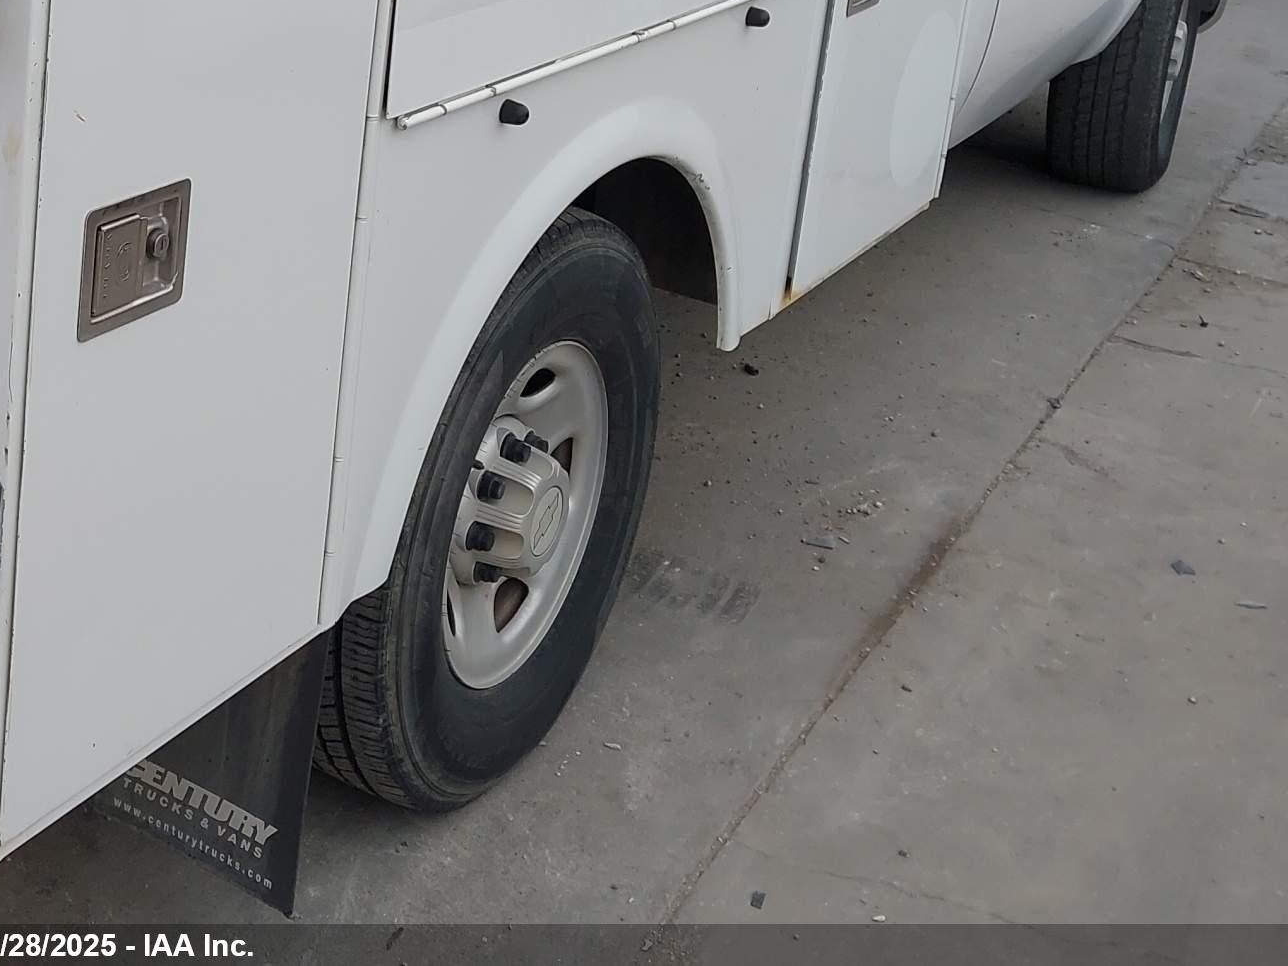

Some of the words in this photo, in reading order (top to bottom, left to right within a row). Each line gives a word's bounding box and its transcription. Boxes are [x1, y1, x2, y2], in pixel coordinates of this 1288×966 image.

[112, 796, 274, 891] www.centurytrucks.com
[121, 778, 194, 821] TRUCKS
[199, 817, 210, 830] &
[216, 825, 265, 860] VANS
